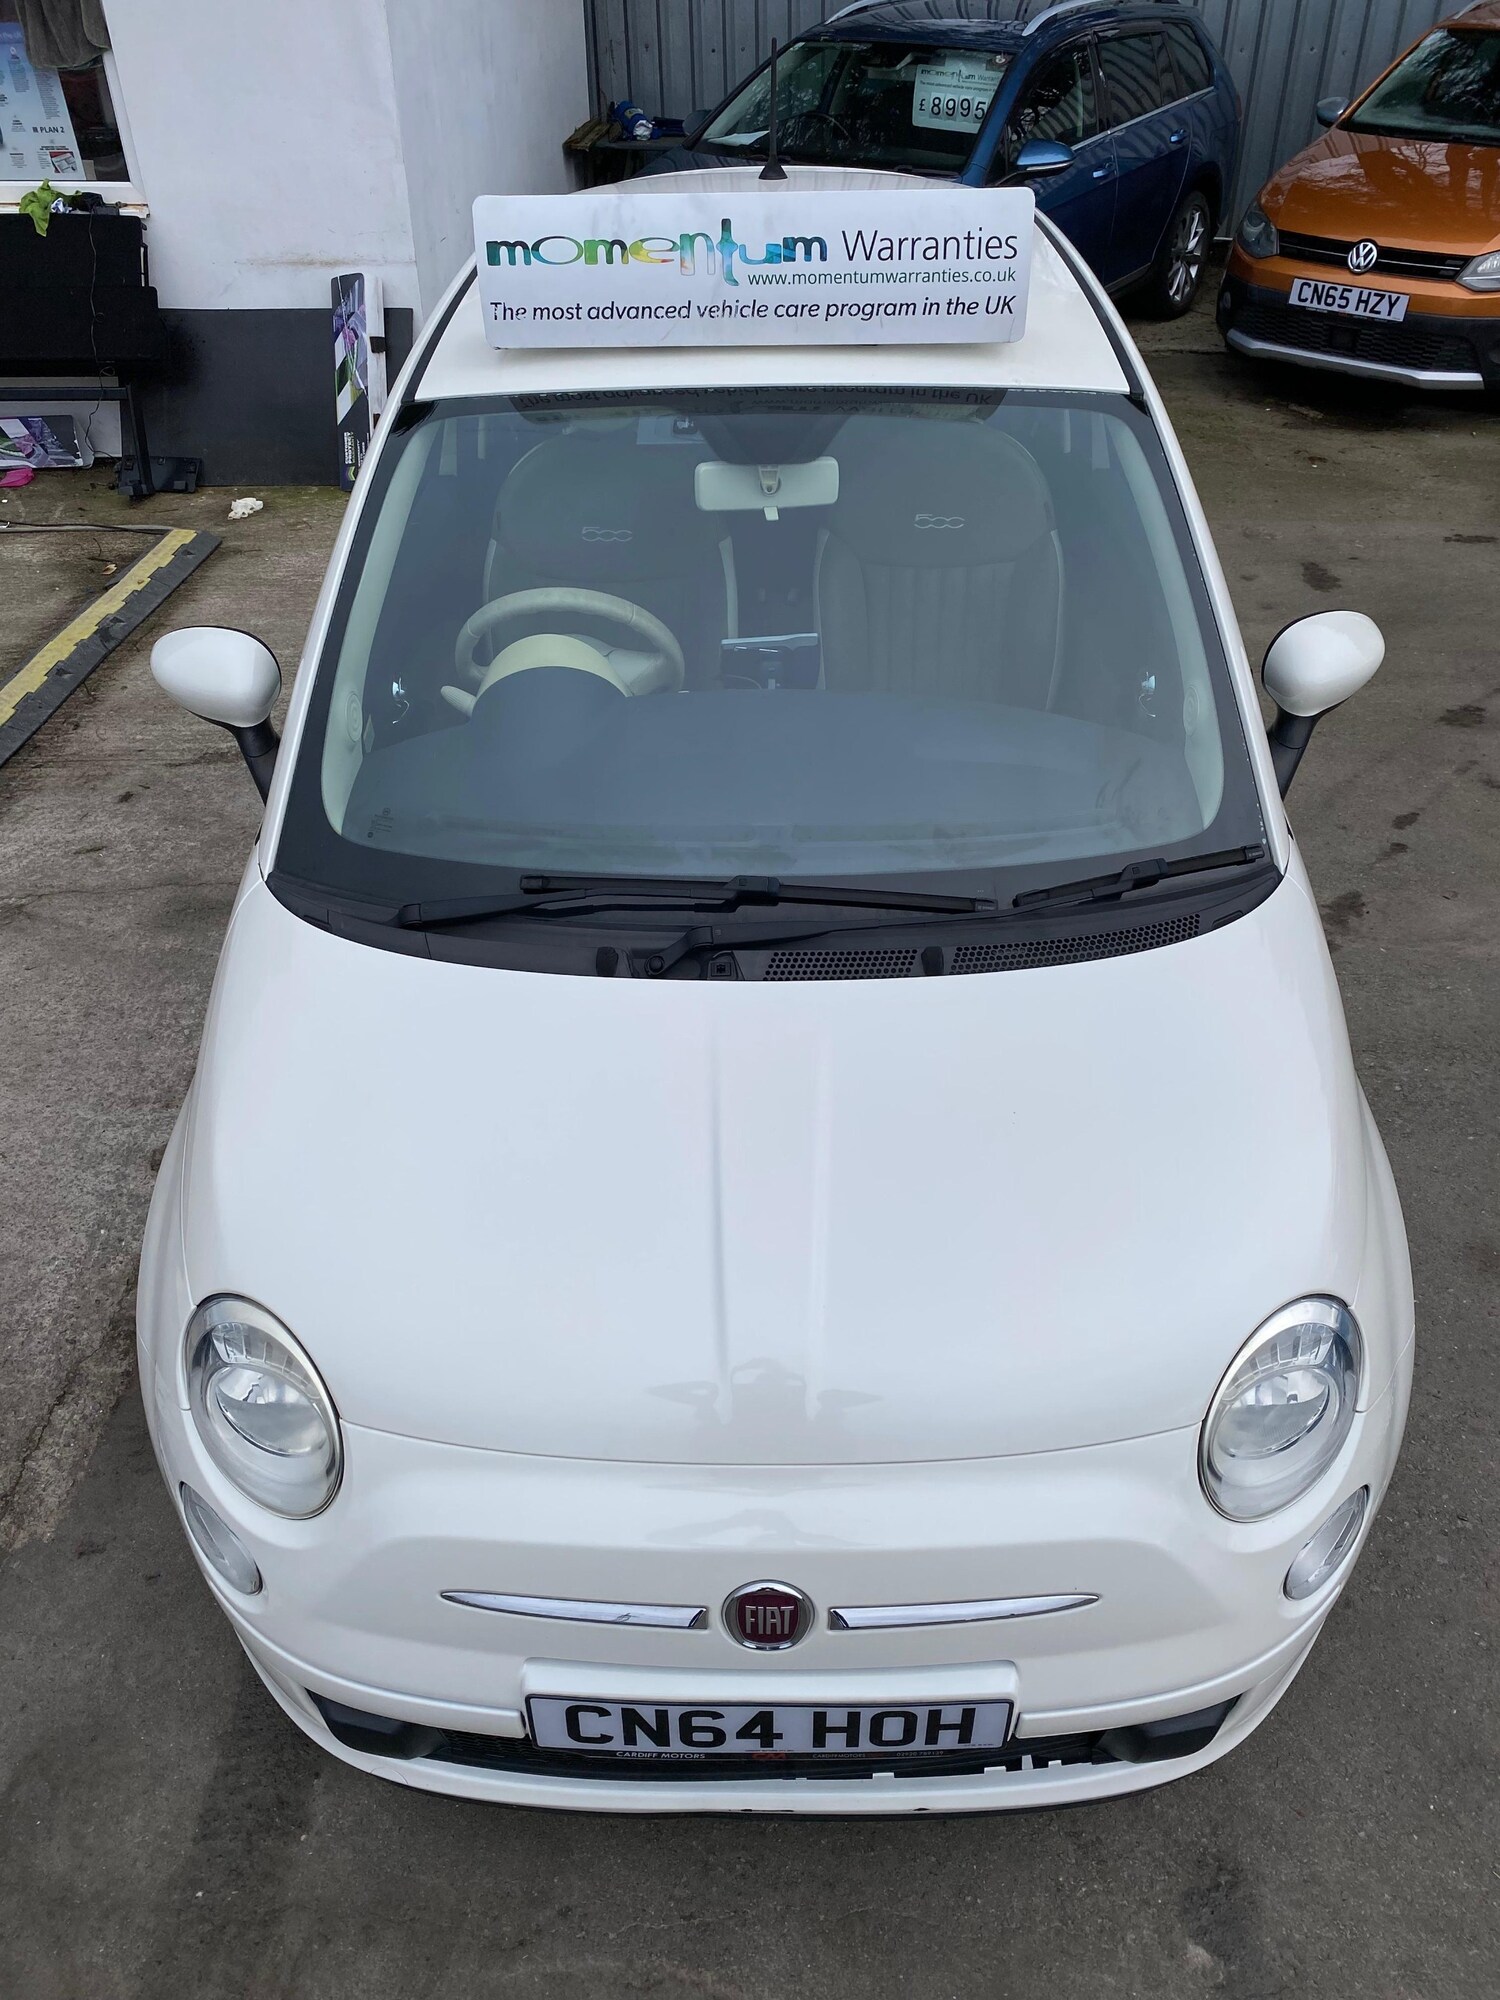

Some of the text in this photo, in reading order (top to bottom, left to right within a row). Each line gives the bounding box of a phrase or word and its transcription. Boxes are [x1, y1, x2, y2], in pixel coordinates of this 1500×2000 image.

[931, 96, 987, 120] 8995
[40, 126, 65, 134] PLAN 2
[485, 218, 1019, 287] momentum Warranties
[747, 266, 1017, 287] www.momentumwarranties.co.uk
[489, 294, 1017, 322] The most advanced vehicle care program in the UK
[1297, 281, 1401, 316] CN65 HZY
[745, 1605, 795, 1635] FIAT
[564, 1704, 978, 1749] CN64 HOH
[615, 1751, 658, 1759] CARDIFF
[660, 1752, 707, 1760] MOTORS
